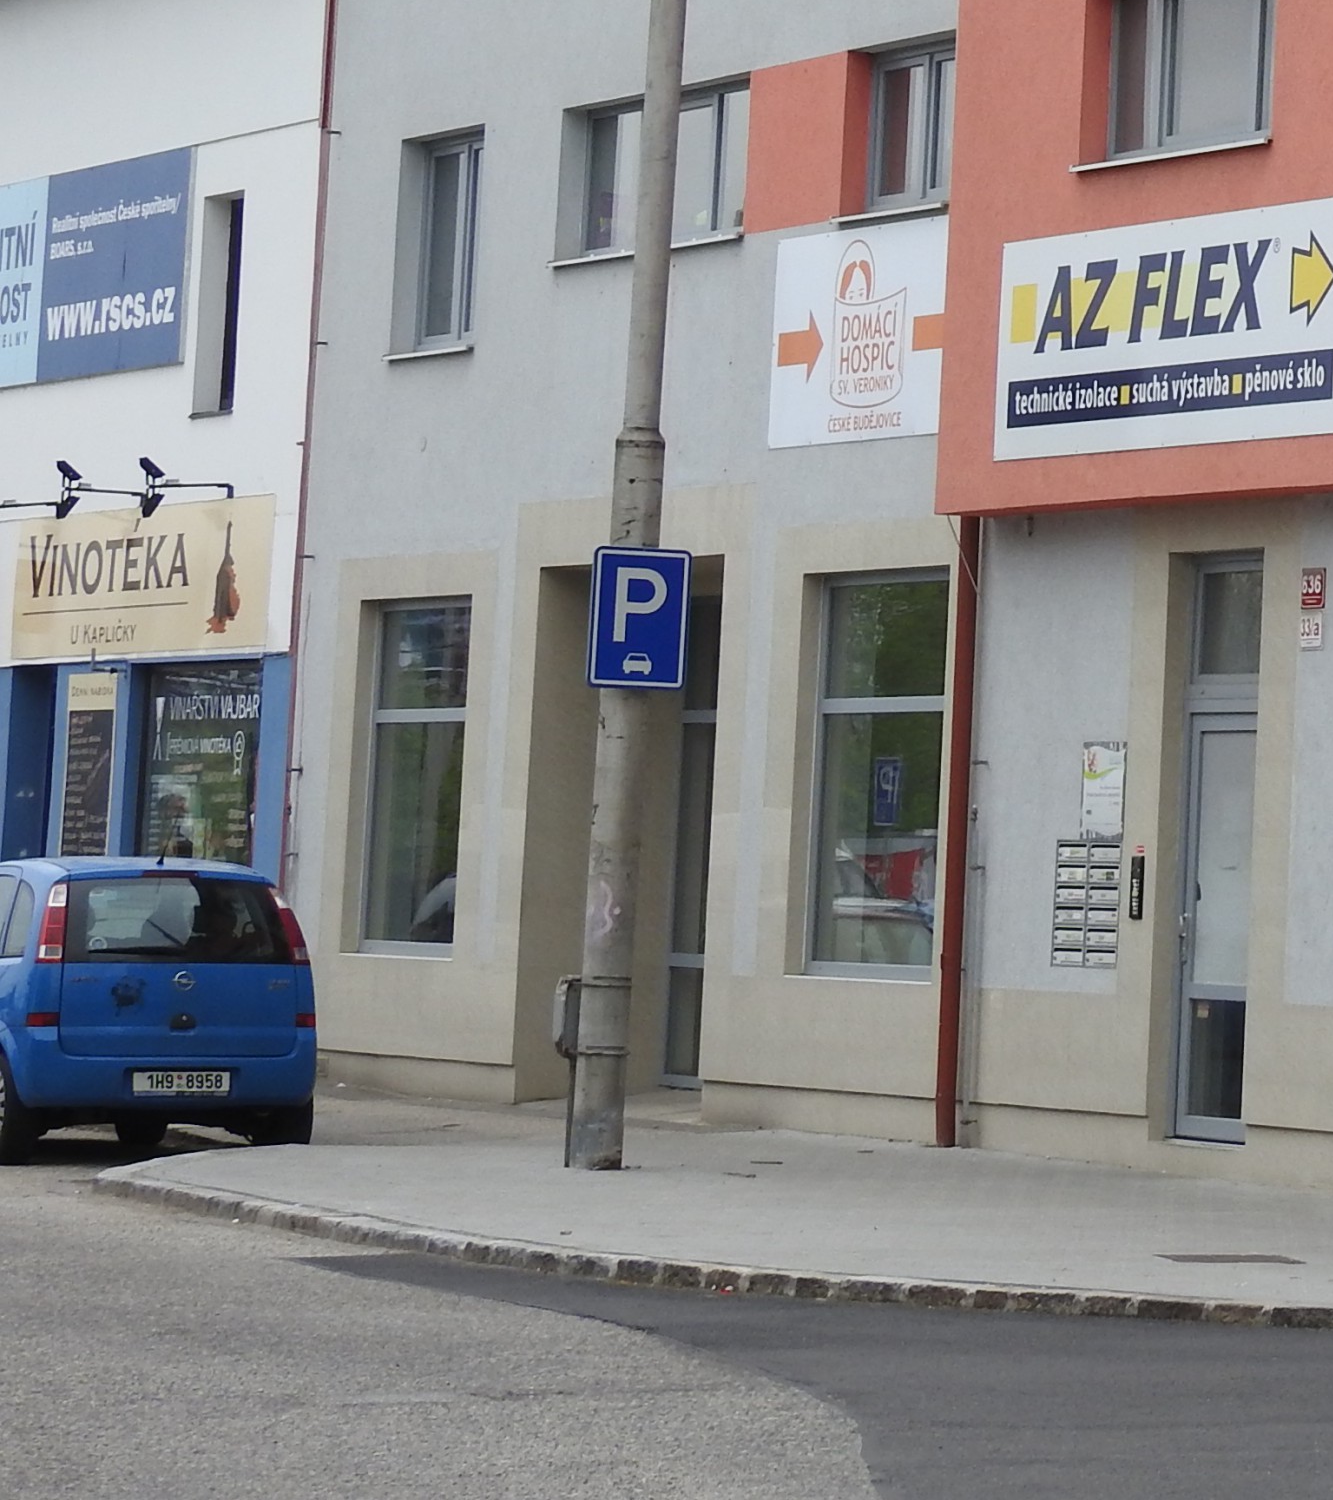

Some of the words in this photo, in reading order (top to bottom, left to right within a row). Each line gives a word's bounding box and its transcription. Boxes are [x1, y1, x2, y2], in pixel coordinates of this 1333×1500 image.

[47, 286, 177, 341] www.rscs.cz
[1033, 259, 1118, 355] AZ
[841, 302, 898, 343] DOMÁCÍ
[839, 341, 896, 375] HOSPIC
[837, 379, 850, 396] SV.
[854, 374, 895, 394] VERONIKY
[1014, 382, 1073, 416] technické
[1075, 380, 1119, 410] izolace
[1132, 374, 1168, 405] suchá
[1172, 368, 1230, 407] výstavba
[1244, 360, 1294, 400] pěnové
[1296, 359, 1325, 391] sklo
[828, 412, 851, 433] ČESKÉ
[853, 410, 902, 432] BUDĚJOVICE
[1302, 575, 1322, 594] 636
[612, 566, 668, 643] P
[70, 625, 79, 645] U
[220, 693, 260, 719] VAJBAR
[147, 1073, 174, 1089] 1H9
[186, 1073, 223, 1089] 8958
